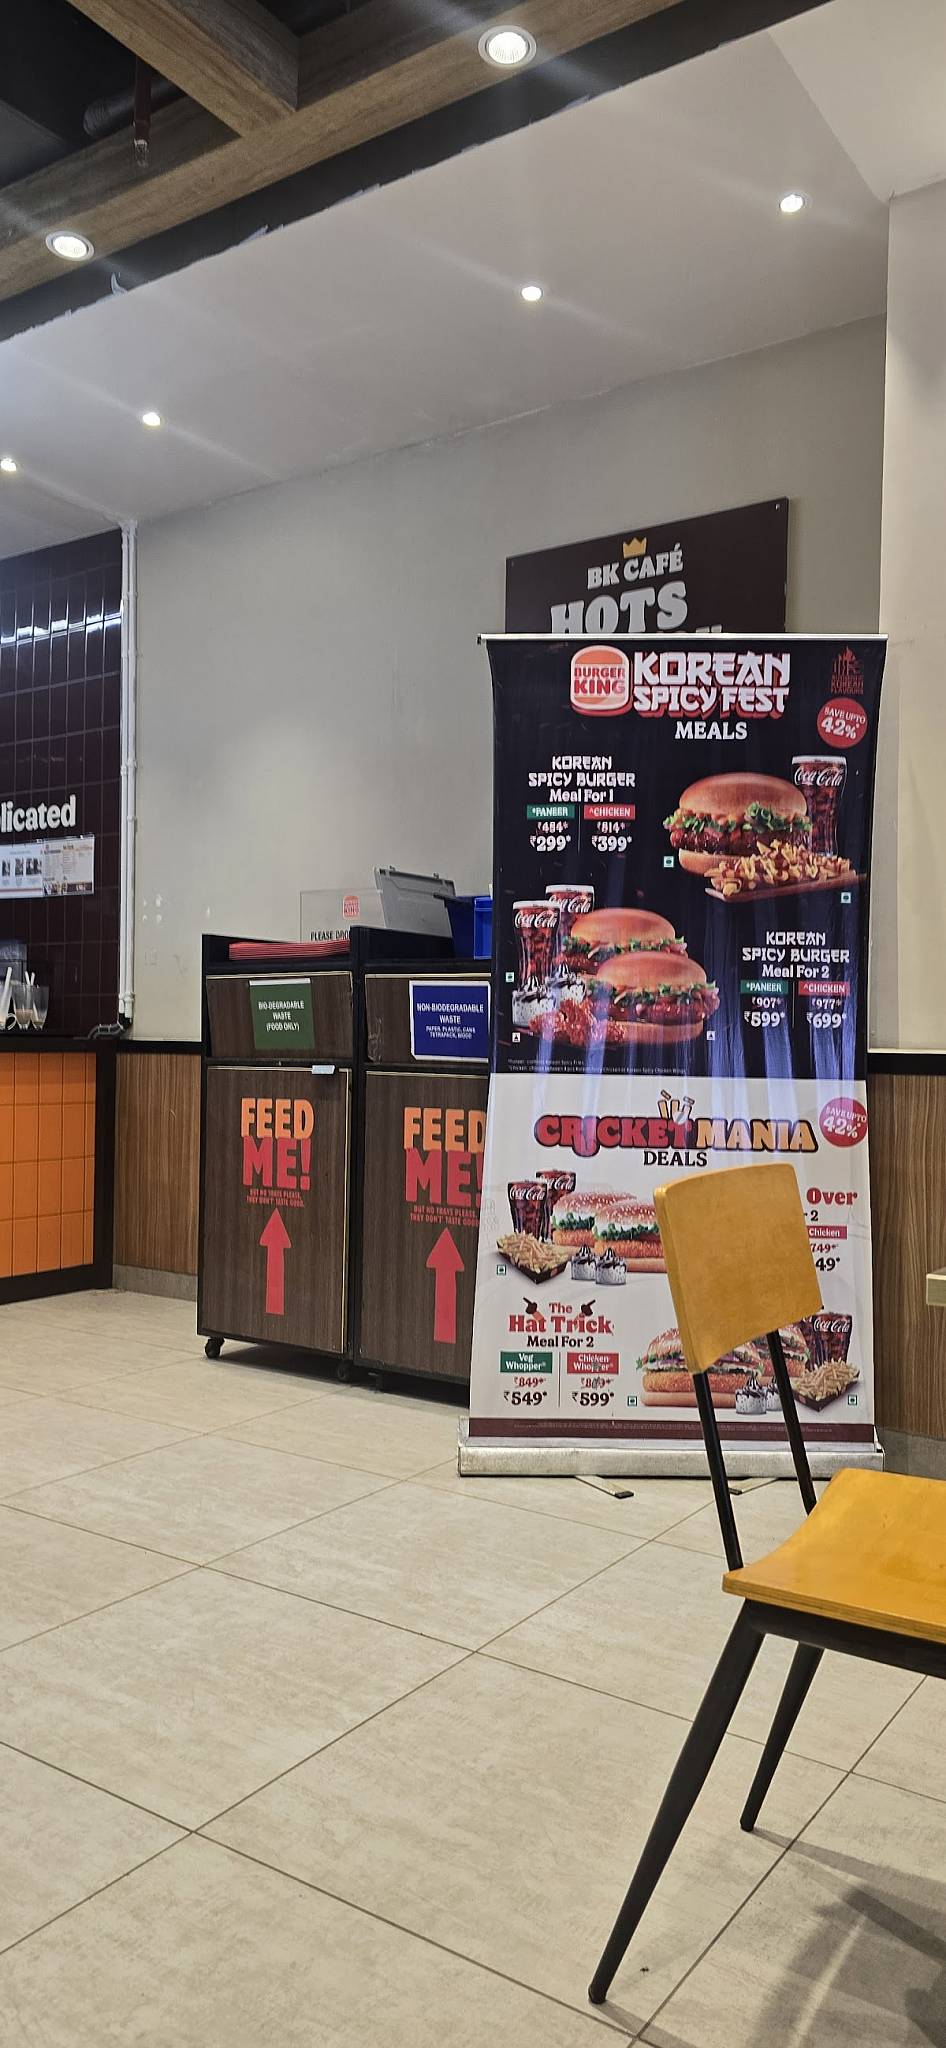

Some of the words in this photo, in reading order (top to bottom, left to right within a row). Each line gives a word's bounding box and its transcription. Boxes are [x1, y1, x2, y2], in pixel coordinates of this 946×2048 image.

[587, 562, 620, 589] BK
[623, 543, 684, 582] CAFÉ
[551, 581, 689, 633] HOTS
[574, 667, 625, 678] BURGER
[634, 651, 791, 686] KOREAN
[574, 680, 626, 695] KING
[633, 686, 717, 713] SPICY
[720, 687, 790, 713] FEST
[824, 707, 845, 719] SAVE
[674, 721, 748, 740] MEALS
[552, 756, 612, 770] KOREAN
[528, 772, 572, 787] SPICY
[576, 773, 636, 788] BURGER
[550, 789, 582, 802] Meal
[584, 789, 606, 803] For
[0, 794, 76, 833] licated
[310, 931, 333, 941] PLEASE
[766, 931, 826, 946] KOREAN
[742, 947, 786, 962] SPICY
[790, 949, 850, 963] BURGER
[761, 964, 794, 978] Meal
[796, 965, 819, 978] For
[821, 965, 830, 979] 2
[258, 1000, 304, 1010] BIO-DEGRADABLE
[417, 1003, 484, 1013] NON-BIODEGRADABLE
[273, 1011, 291, 1020] WASTE
[440, 1015, 460, 1024] WASTE
[241, 1098, 315, 1140] FEED
[403, 1107, 487, 1153] FEED
[537, 1116, 692, 1157] CRICKET
[696, 1119, 818, 1152] MANIA
[243, 1136, 312, 1190] ME!
[643, 1151, 707, 1167] DEALS
[806, 1188, 857, 1205] Over
[810, 1209, 819, 1221] 2
[808, 1227, 840, 1237] Chicken
[549, 1302, 573, 1314] The
[509, 1315, 547, 1333] Hat
[551, 1313, 614, 1334] Trick
[527, 1335, 559, 1347] Meal
[561, 1337, 584, 1347] For
[586, 1337, 594, 1348] 2
[519, 1353, 534, 1363] Veg
